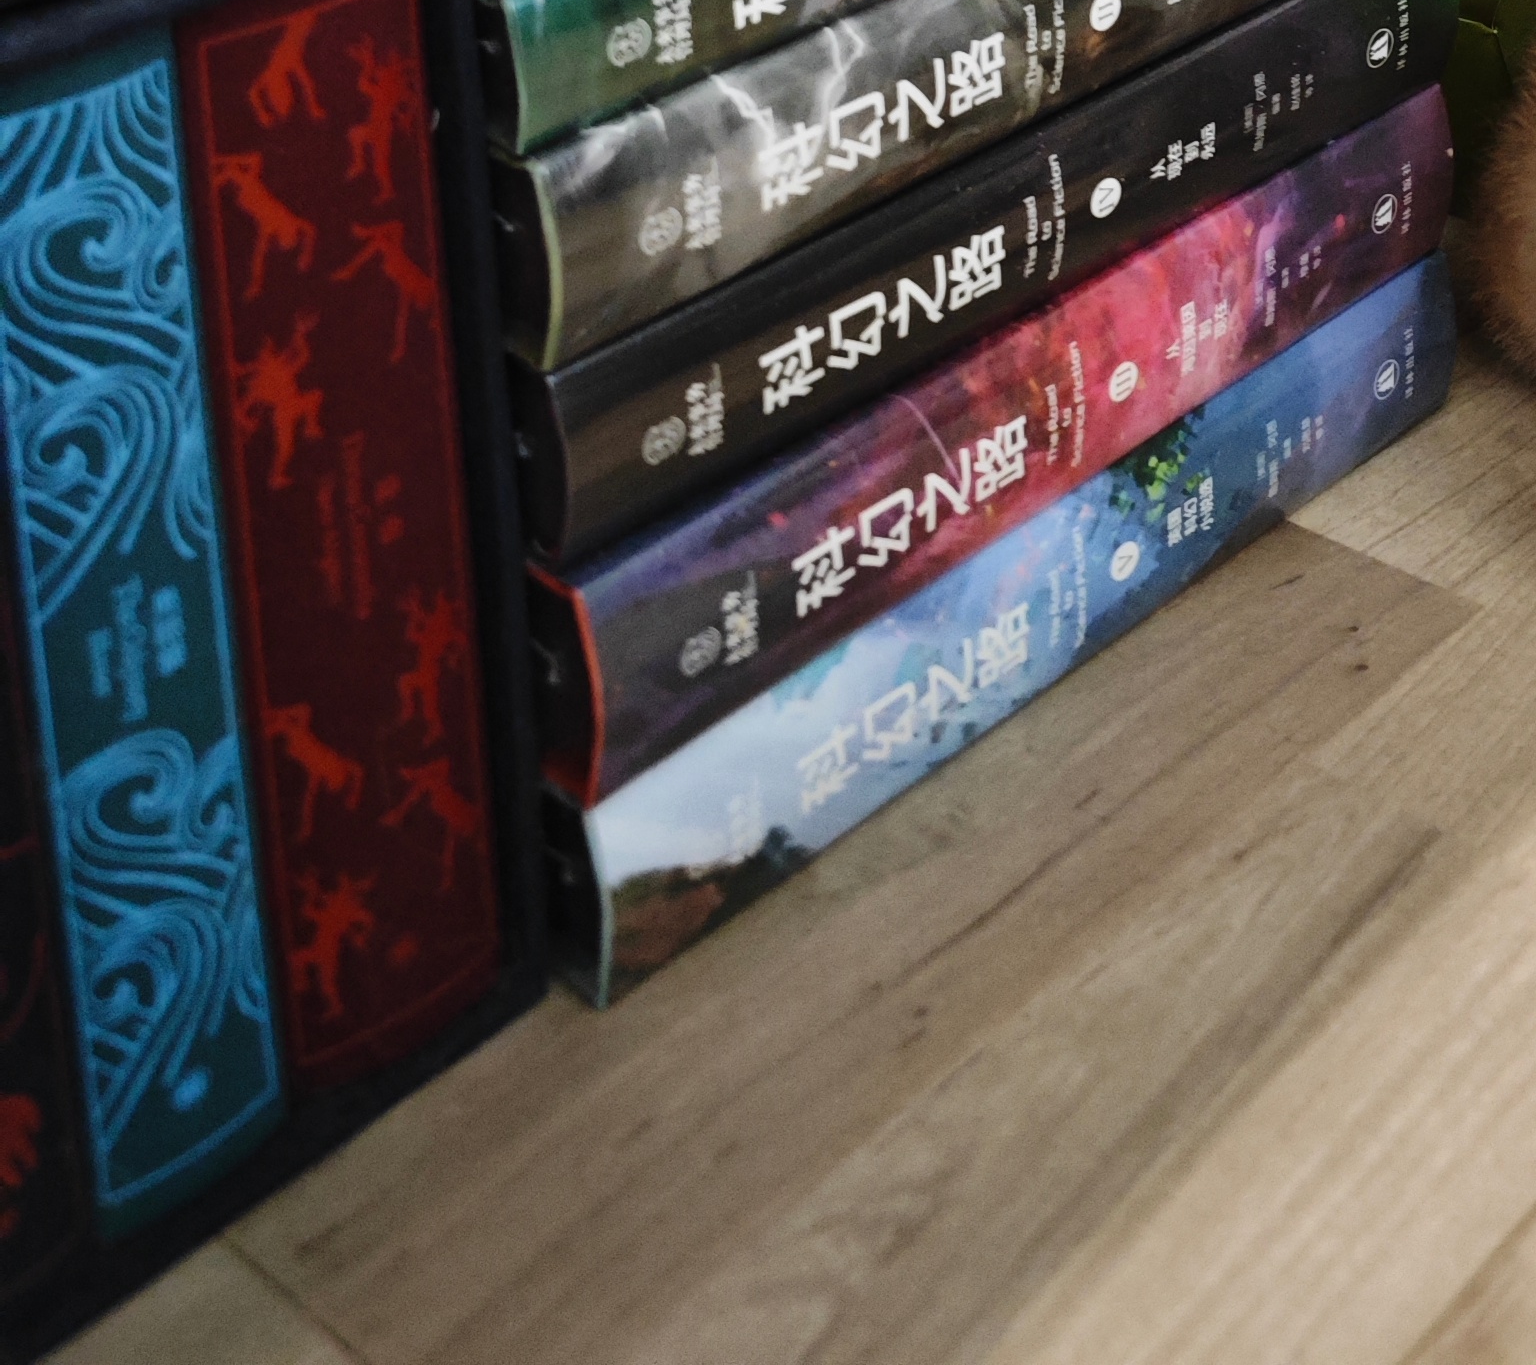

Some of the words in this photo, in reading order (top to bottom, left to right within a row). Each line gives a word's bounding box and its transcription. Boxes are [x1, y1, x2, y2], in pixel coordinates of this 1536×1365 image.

[757, 31, 1007, 212] 科幻之路
[758, 225, 1007, 415] 科幻之路
[792, 415, 1029, 618] 科幻之路
[797, 602, 1030, 815] 科幻之路
